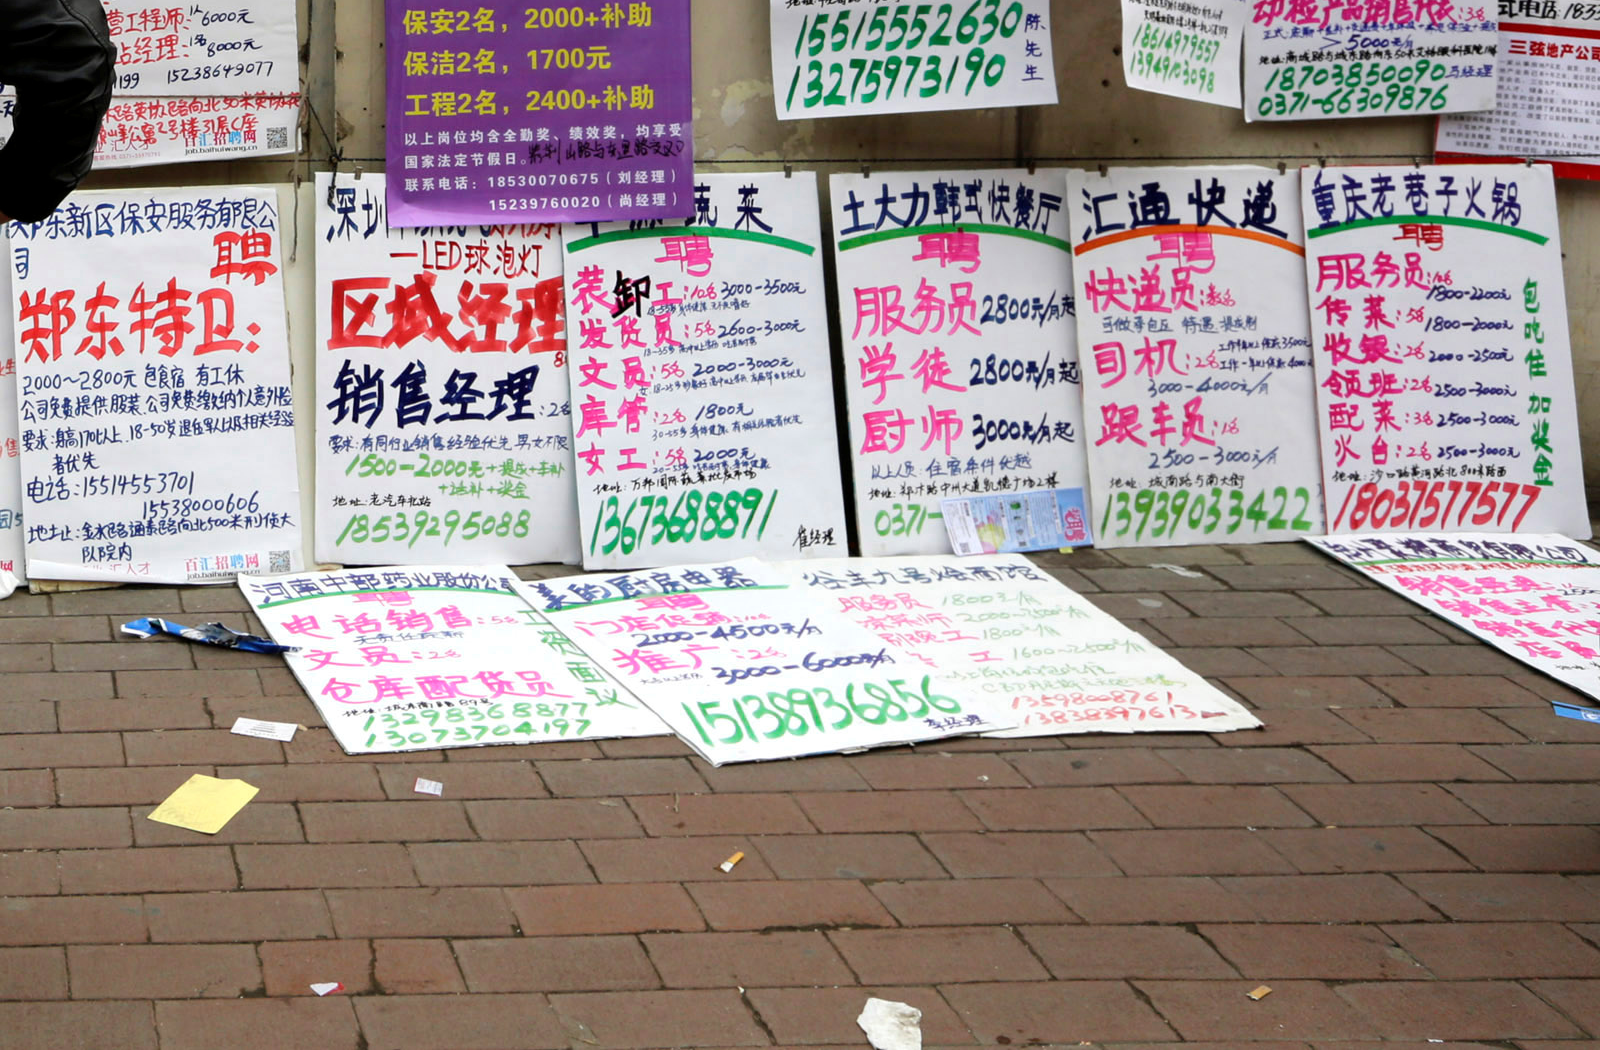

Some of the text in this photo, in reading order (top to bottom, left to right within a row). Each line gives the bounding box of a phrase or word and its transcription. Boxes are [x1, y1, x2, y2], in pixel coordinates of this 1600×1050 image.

[526, 45, 611, 71] 1700元
[785, 48, 1007, 113] 13275973190
[1082, 177, 1289, 241] 汇通快递
[851, 277, 982, 342] 服务员
[858, 341, 968, 406] 学徒
[858, 404, 965, 456] 厨师
[335, 509, 531, 548] 18539295088
[1102, 486, 1313, 541] 13939033422
[681, 674, 963, 747] 15138936856
